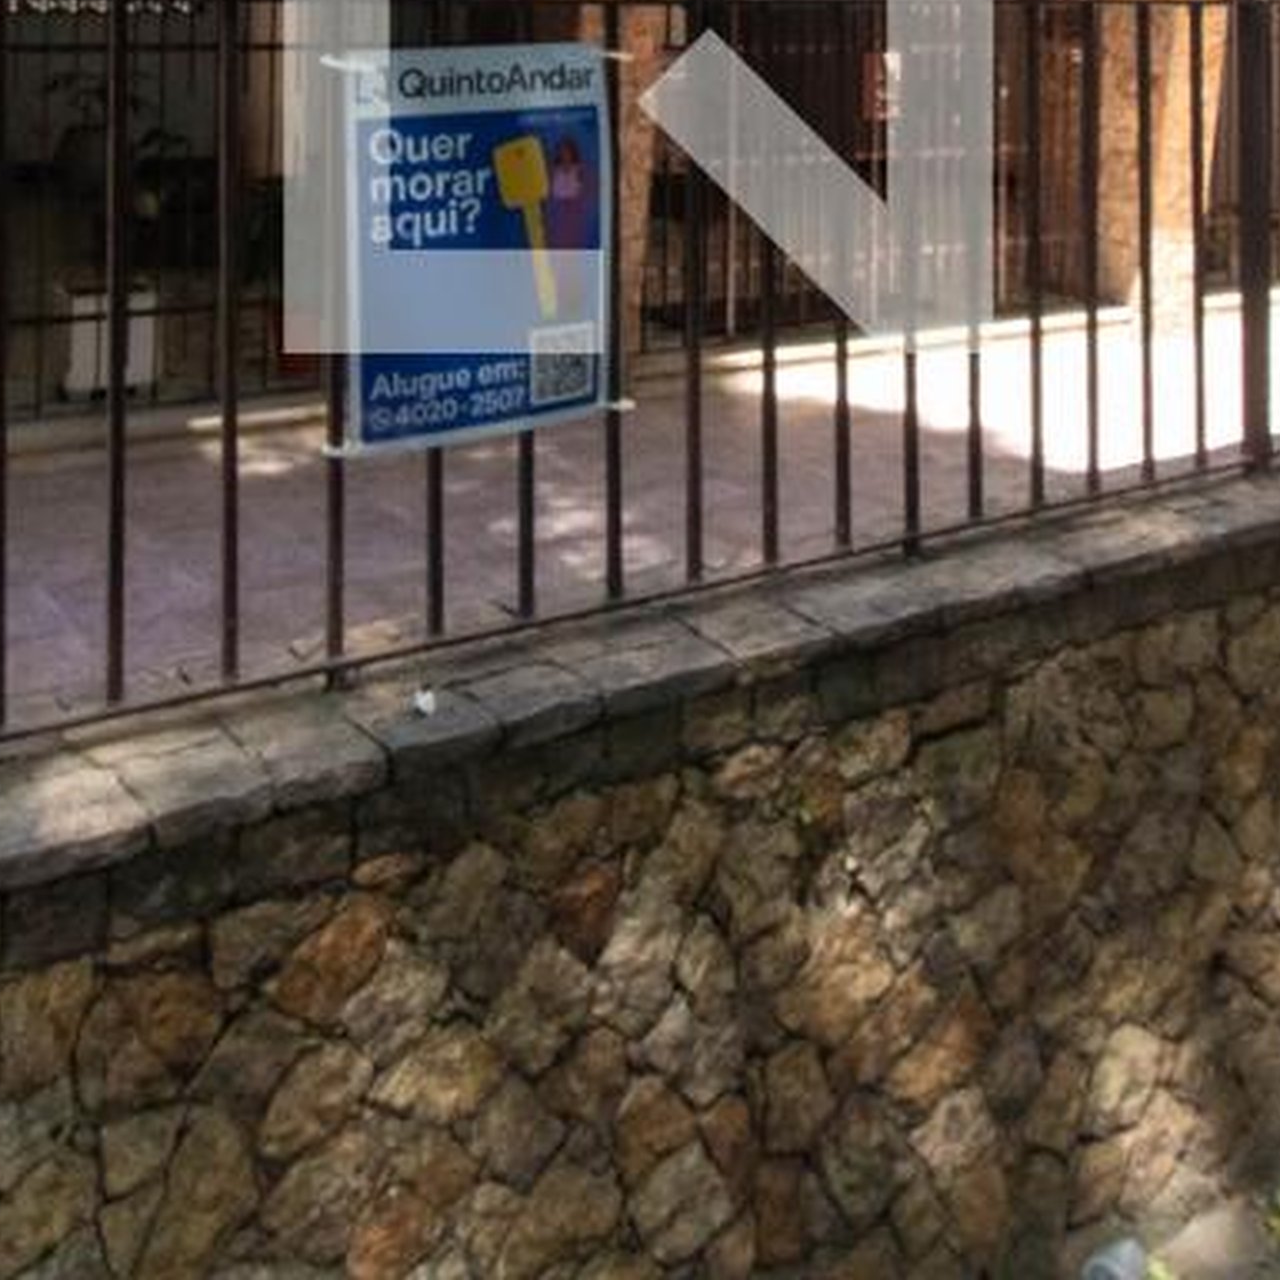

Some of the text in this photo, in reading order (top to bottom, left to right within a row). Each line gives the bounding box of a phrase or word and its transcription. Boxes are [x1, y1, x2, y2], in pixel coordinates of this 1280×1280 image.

[398, 63, 594, 98] QuintoAndar
[370, 128, 472, 165] Quer
[371, 167, 492, 201] morar
[371, 200, 480, 246] aqui?
[370, 370, 471, 401] Alugue
